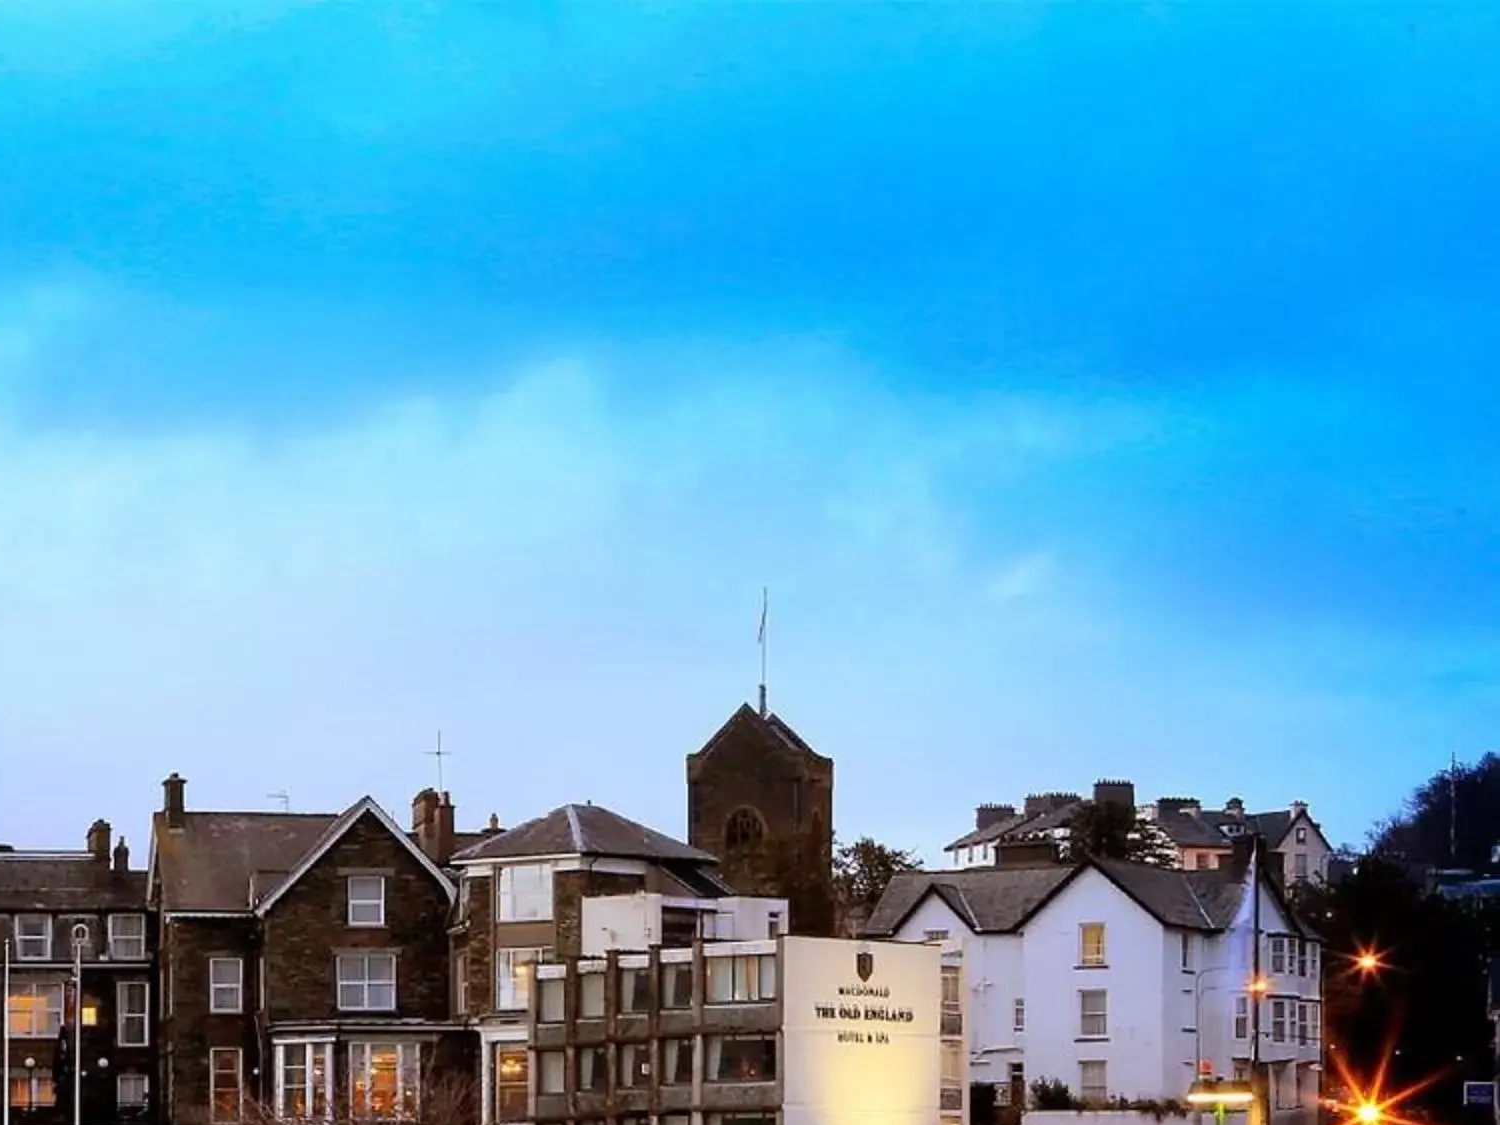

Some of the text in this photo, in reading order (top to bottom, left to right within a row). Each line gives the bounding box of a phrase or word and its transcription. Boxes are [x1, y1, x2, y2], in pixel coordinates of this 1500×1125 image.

[814, 1007, 914, 1022] THE OLD ENGLAND
[838, 1032, 864, 1043] HOTEL
